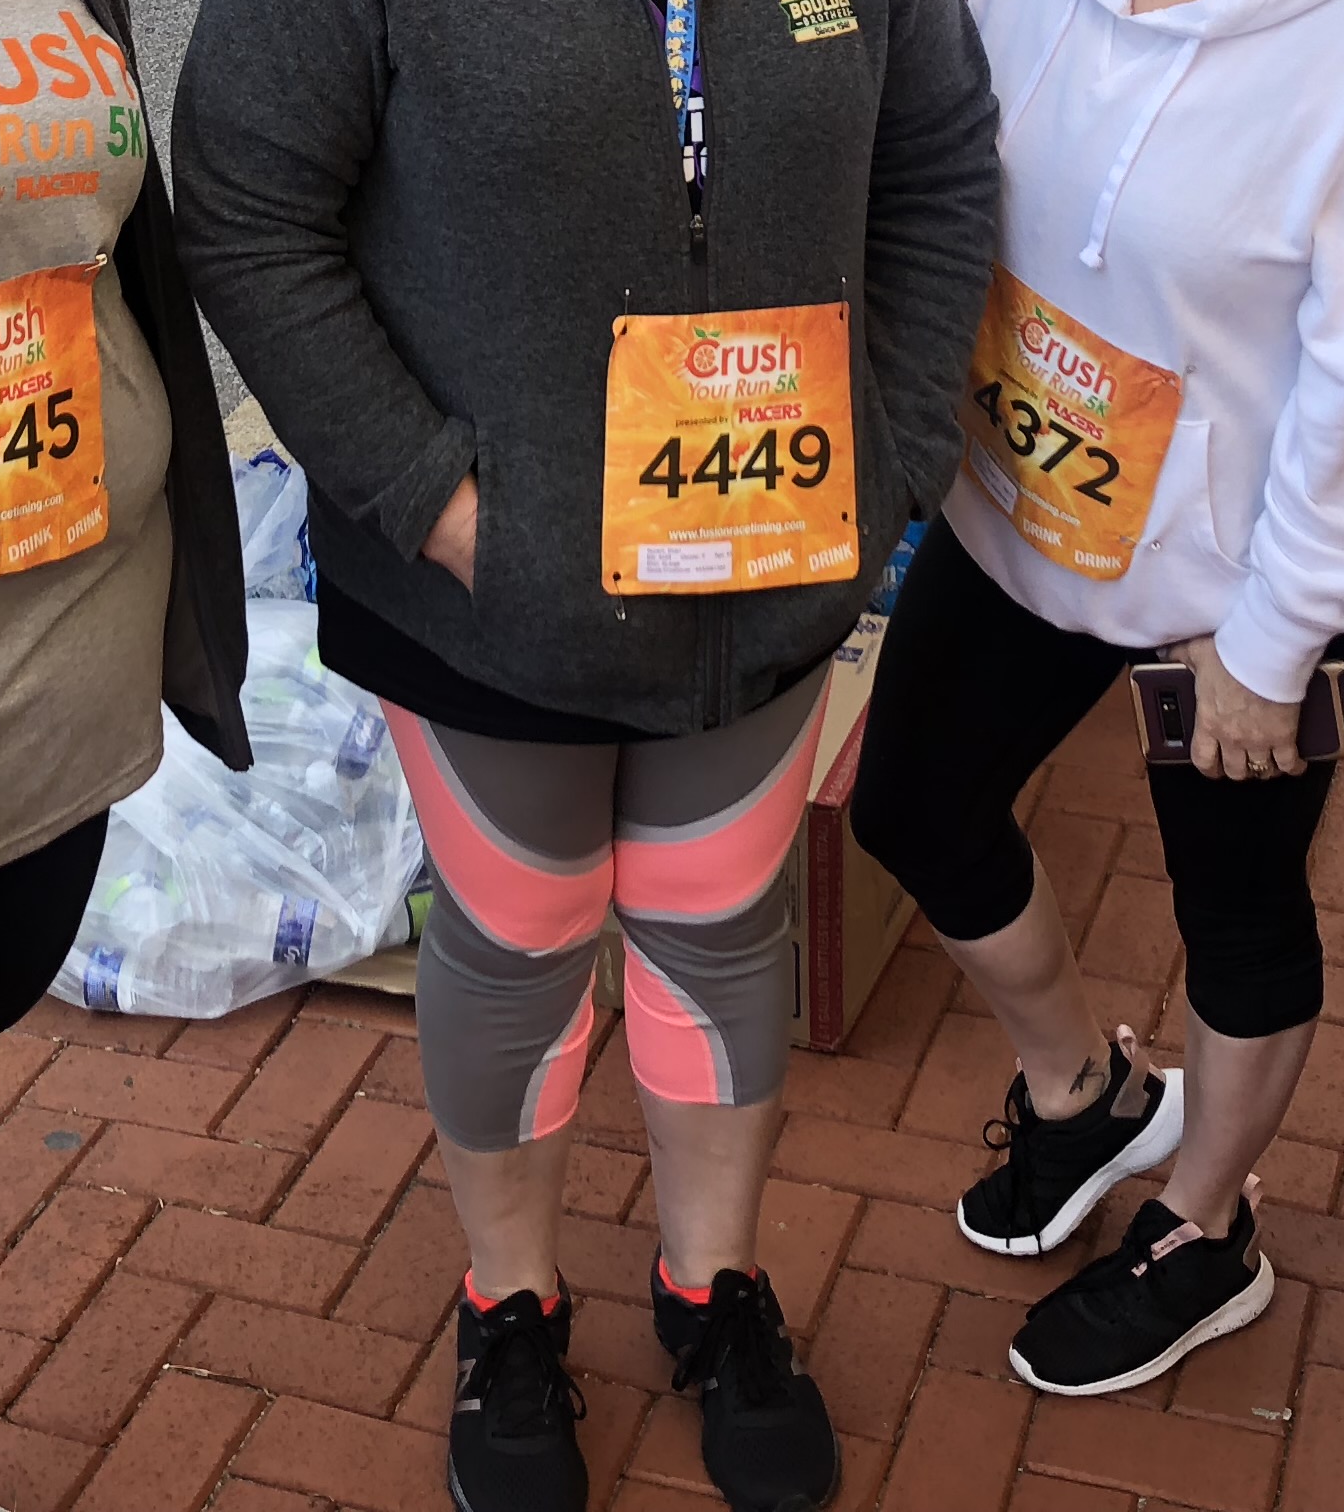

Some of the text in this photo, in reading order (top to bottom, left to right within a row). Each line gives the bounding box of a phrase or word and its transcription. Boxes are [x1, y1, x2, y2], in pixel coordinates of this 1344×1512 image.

[107, 106, 144, 158] 5K
[26, 339, 47, 366] 5K
[685, 332, 802, 378] Crush
[1020, 318, 1118, 402] Crush
[689, 373, 800, 401] Your Run 5K
[1049, 371, 1082, 402] Run
[1084, 394, 1110, 418] 5K
[675, 416, 718, 428] presented
[719, 415, 729, 426] by
[973, 381, 1121, 507] 4372
[639, 425, 831, 498] 4449
[7, 524, 53, 563] DRINK
[66, 505, 104, 545] DRINK
[668, 519, 806, 540] www.fusionracetiming.com
[1022, 518, 1123, 570] DRINK DRINK
[747, 548, 795, 578] DRINK
[808, 542, 855, 573] DRINK
